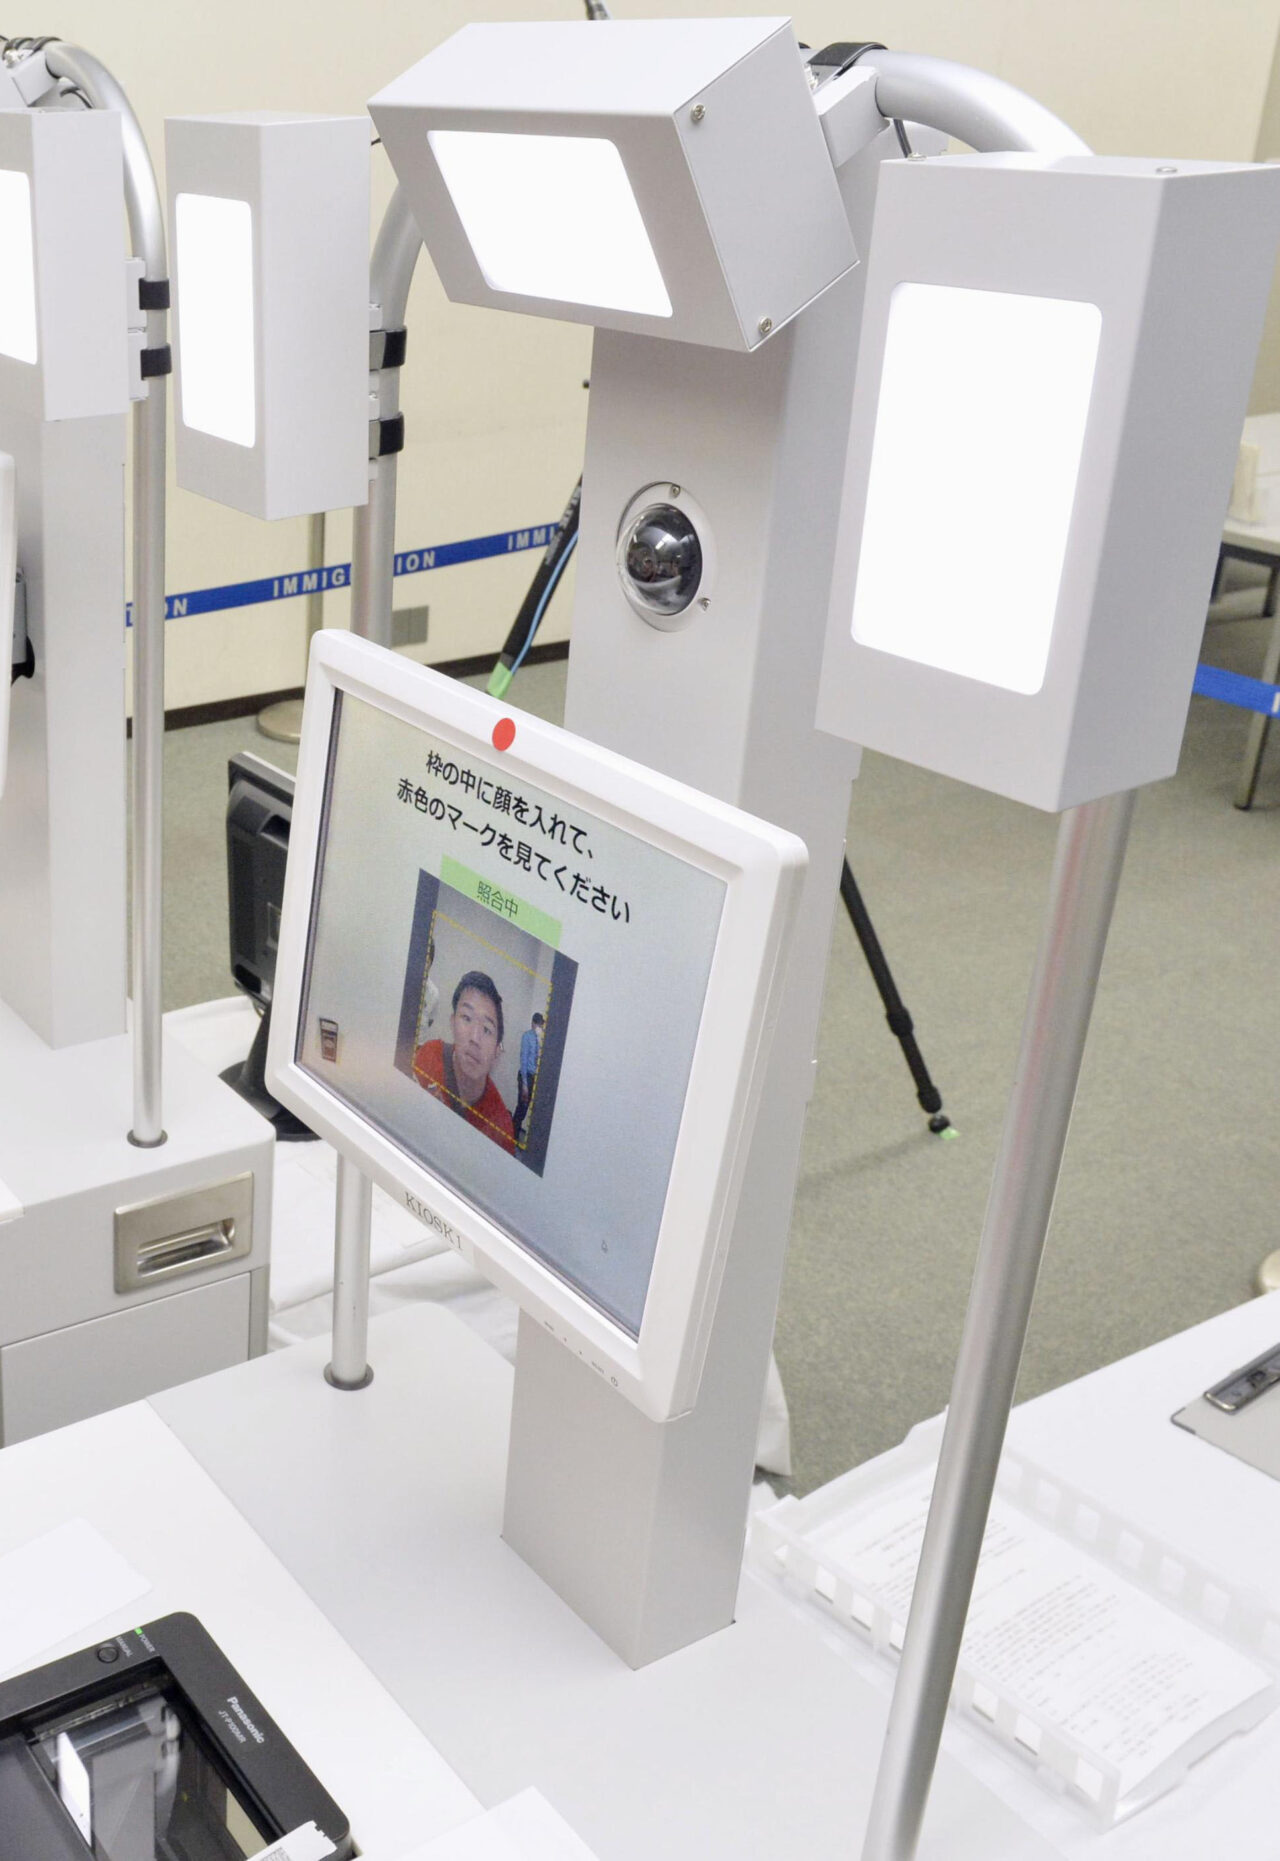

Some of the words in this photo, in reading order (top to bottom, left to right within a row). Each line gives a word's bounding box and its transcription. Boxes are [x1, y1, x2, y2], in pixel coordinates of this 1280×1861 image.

[425, 750, 593, 859] 枠の中に顔を入れて、
[397, 778, 630, 923] 赤色のマークを見てください
[476, 880, 518, 918] 照合中
[227, 1696, 265, 1743] Panasonic
